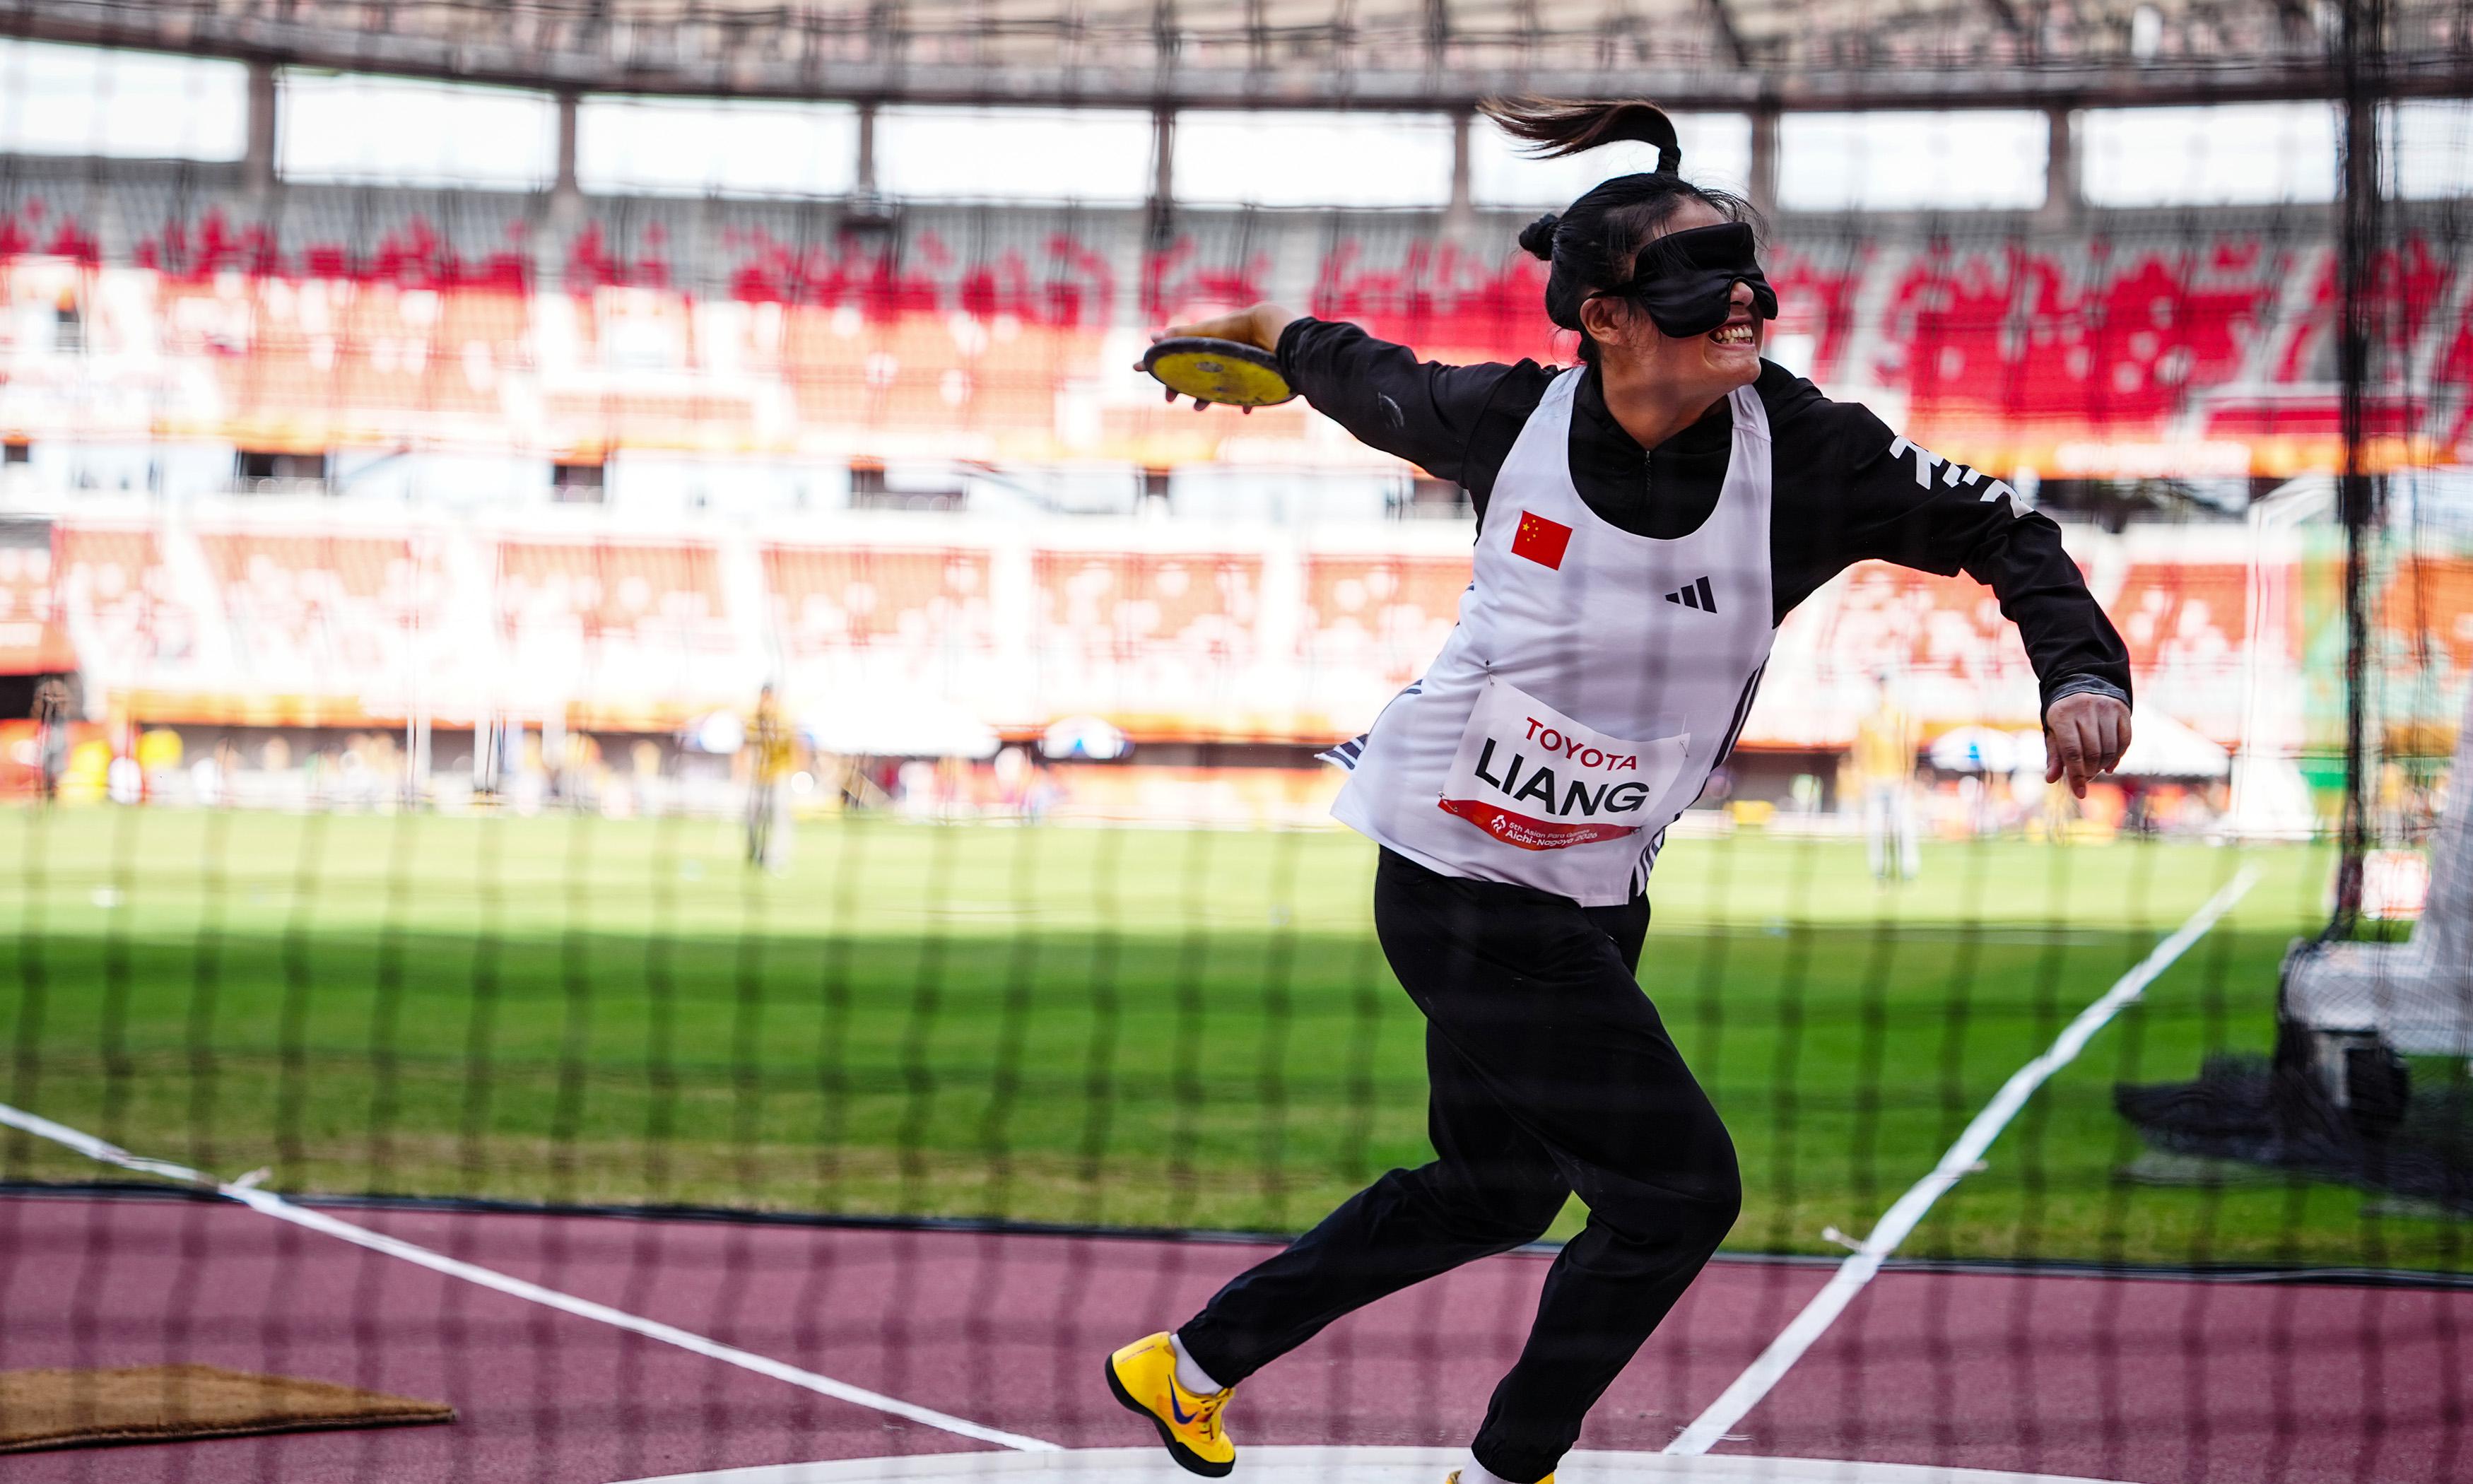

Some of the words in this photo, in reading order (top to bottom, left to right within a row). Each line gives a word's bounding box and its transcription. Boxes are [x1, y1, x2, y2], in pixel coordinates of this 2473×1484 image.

[1526, 717, 1637, 771] TOYOTA
[1474, 737, 1650, 816] LIANG
[1505, 830, 1573, 847] Aichi-Nagoya
[1575, 832, 1598, 842] 2026
[1509, 822, 1523, 832] 5th
[1524, 828, 1546, 838] Asian
